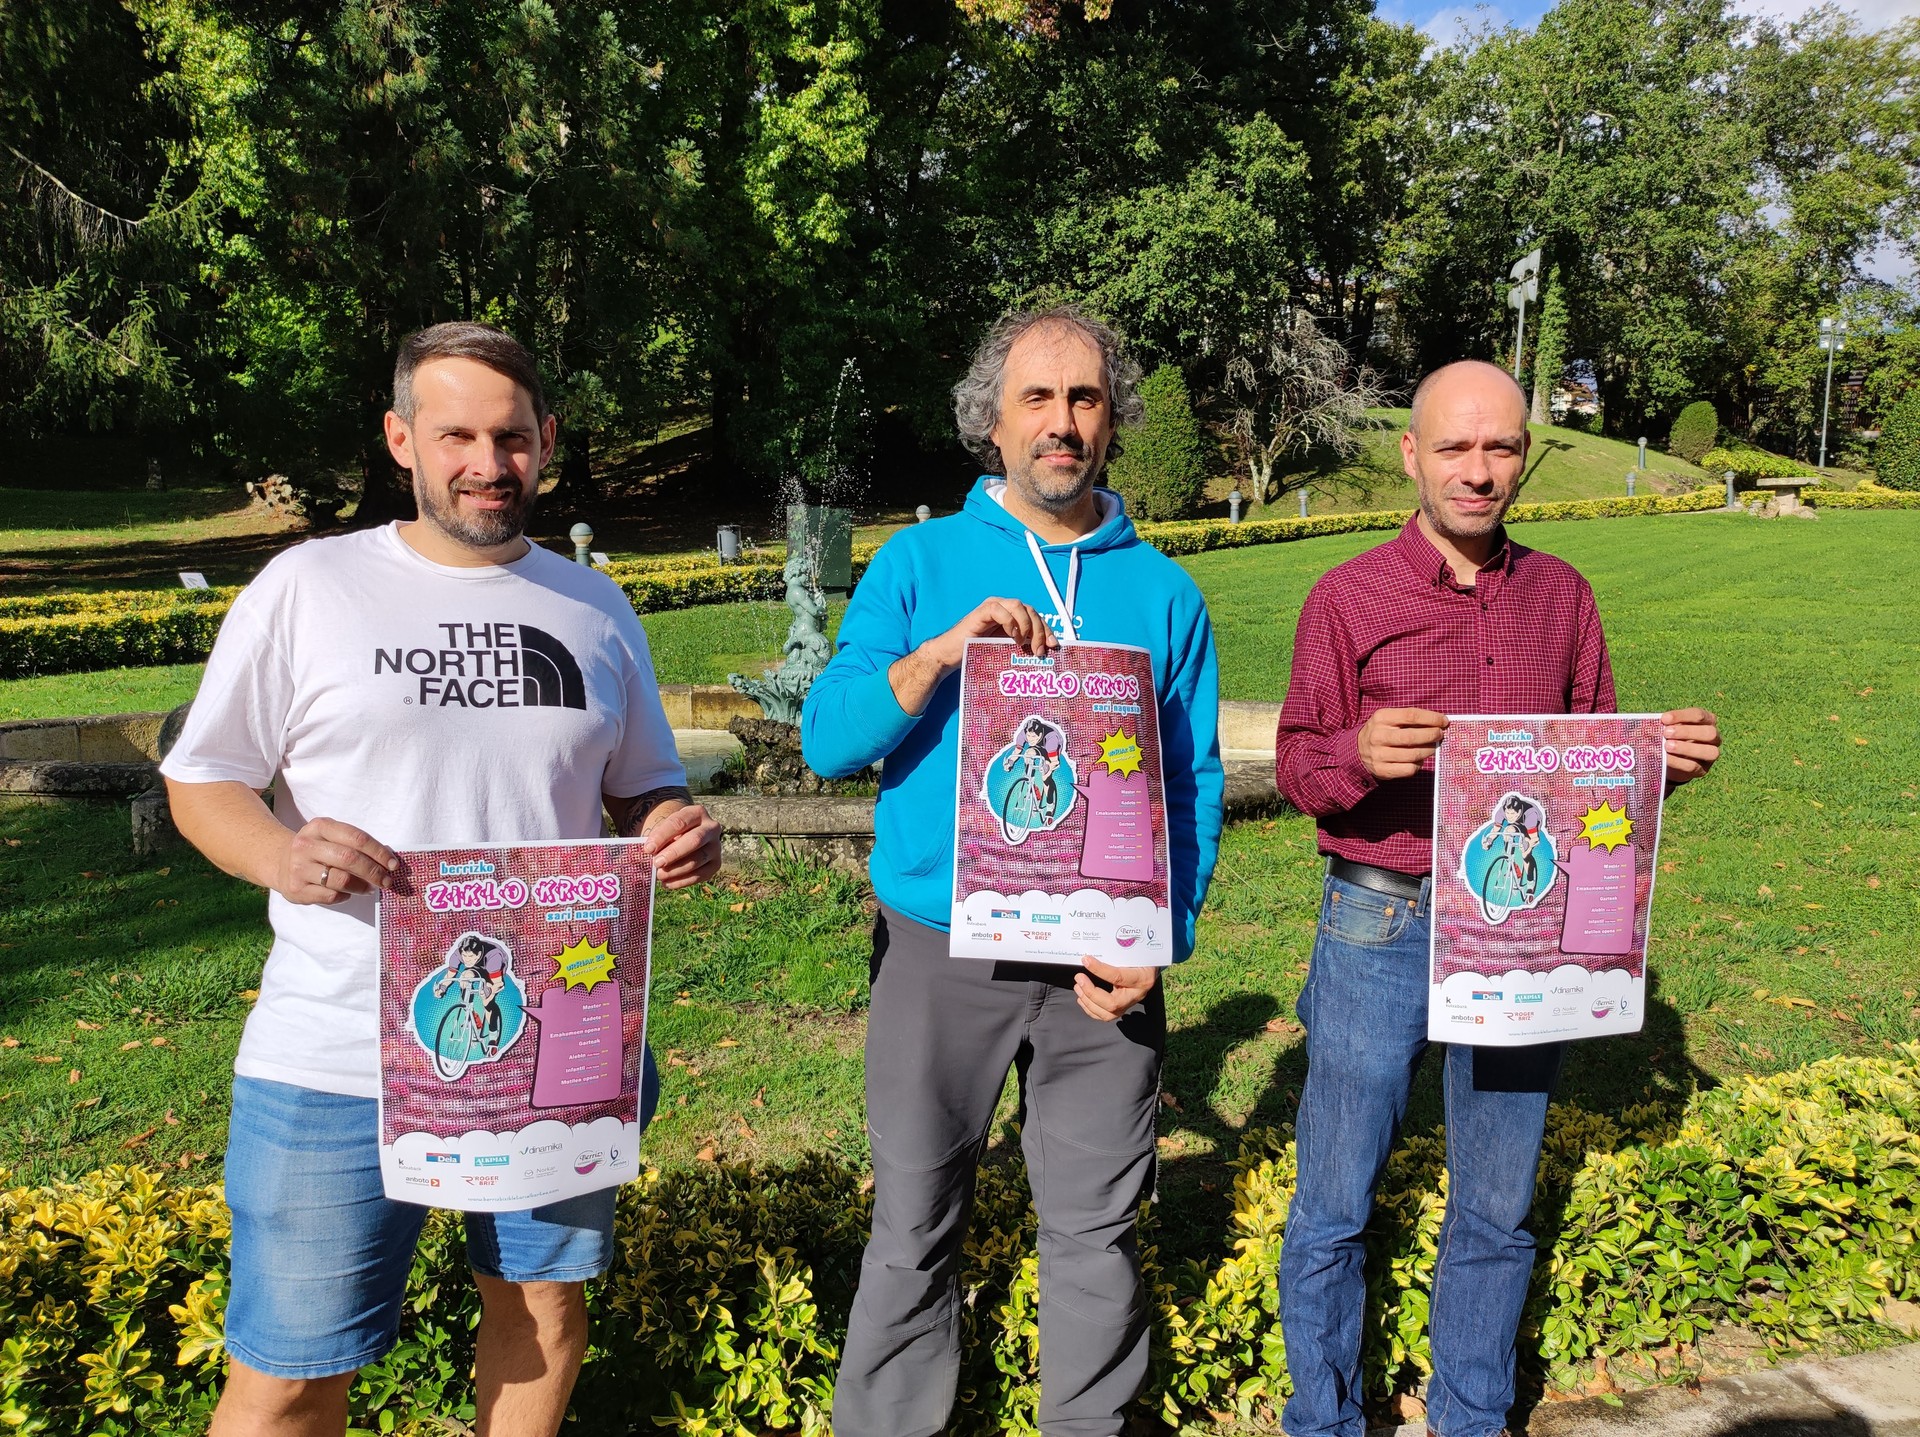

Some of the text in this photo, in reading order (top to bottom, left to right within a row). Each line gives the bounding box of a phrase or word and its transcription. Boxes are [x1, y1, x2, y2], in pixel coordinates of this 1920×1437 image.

[438, 622, 517, 648] THE
[374, 648, 519, 677] NORTH
[1011, 654, 1054, 665] berrizko
[419, 676, 519, 708] FACE
[1002, 672, 1139, 699] ZIKLO KROS
[1093, 703, 1141, 715] sari nagusia
[1489, 730, 1533, 741] berrizko
[1478, 747, 1634, 772] ZIKLO KROS
[1574, 774, 1635, 788] sari nagusia
[441, 861, 494, 875] berrizko
[427, 875, 620, 911] ZIKLO KROS
[546, 907, 619, 923] sari nagusia
[529, 1142, 563, 1154] dinamika
[437, 1155, 458, 1163] Dela
[405, 1175, 429, 1184] anboto
